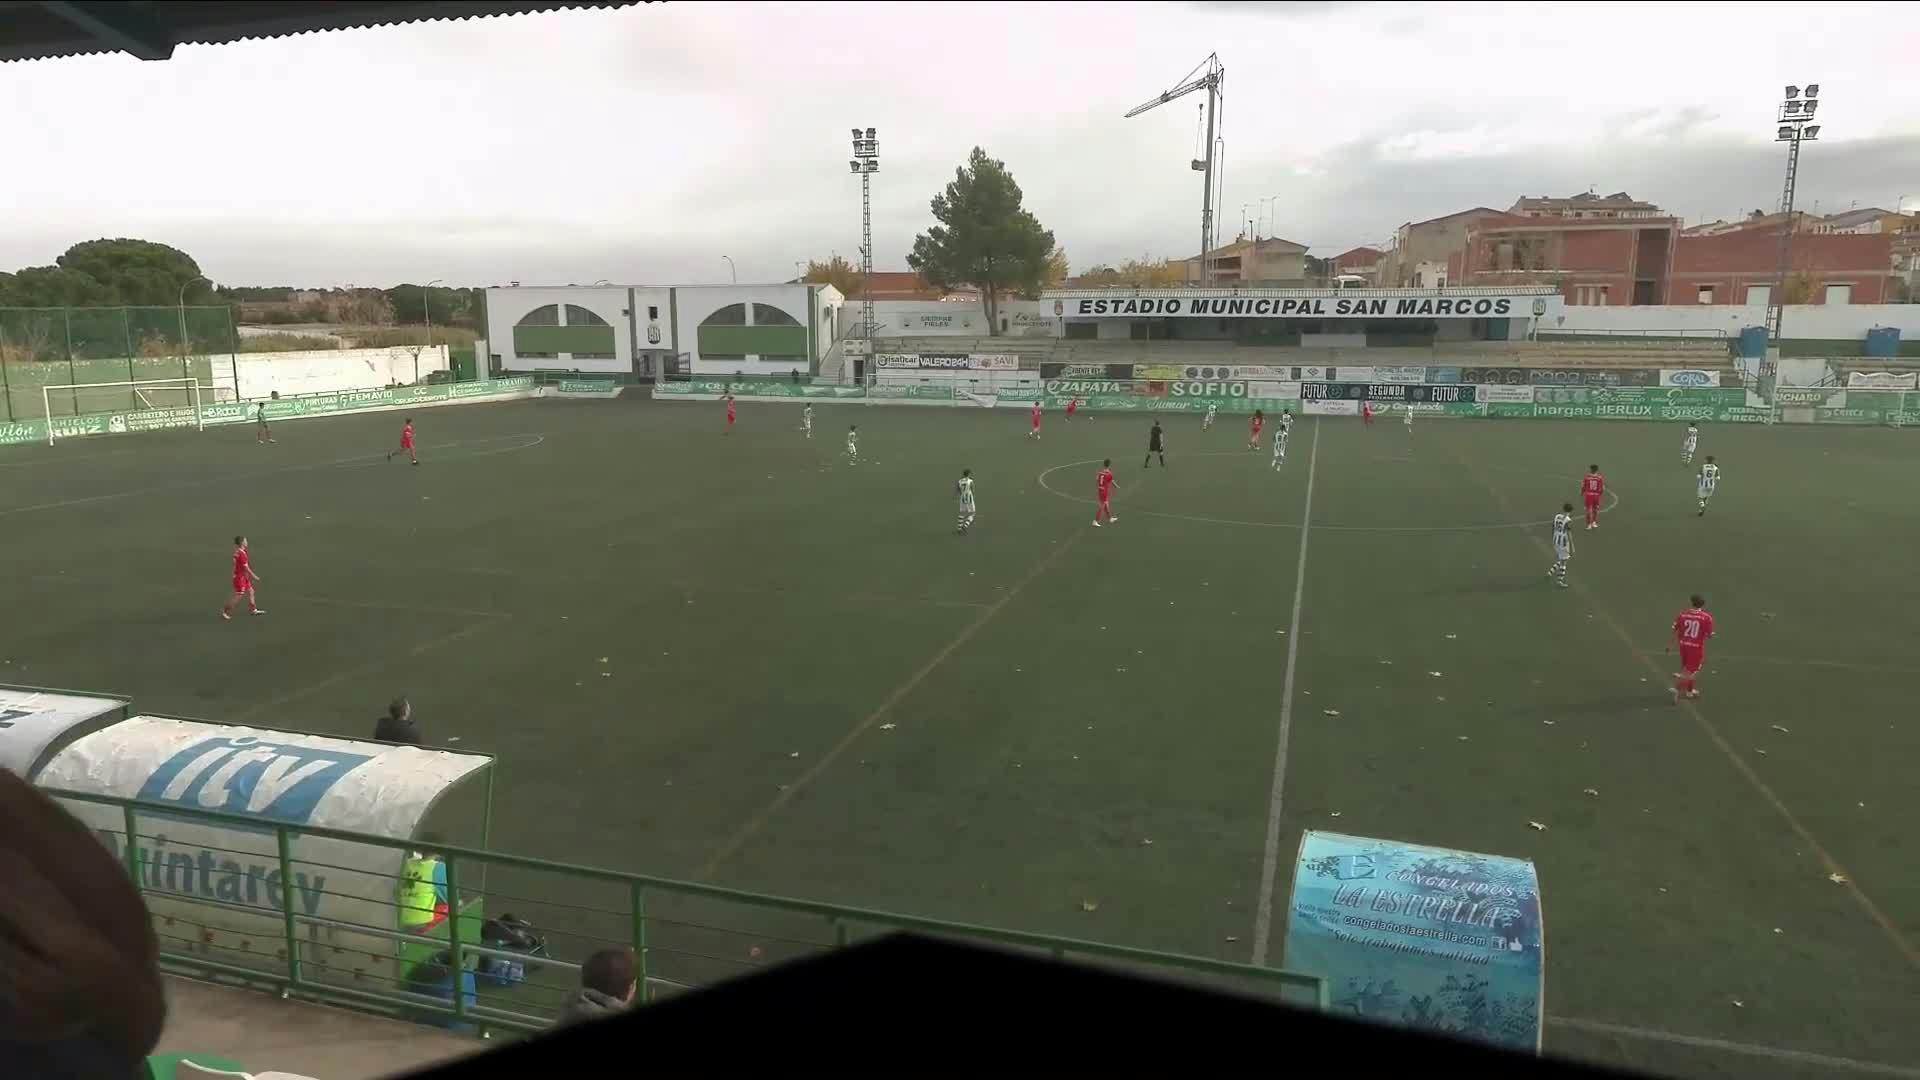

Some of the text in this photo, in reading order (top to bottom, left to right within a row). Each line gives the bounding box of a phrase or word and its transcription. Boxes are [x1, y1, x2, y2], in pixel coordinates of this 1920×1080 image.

[1079, 299, 1511, 314] ESTADIO MUNICIPAL SAN MARCOS
[1672, 373, 1706, 384] CORAL
[1060, 382, 1121, 392] ZAPATA
[1171, 382, 1246, 397] SOFIO
[1302, 384, 1328, 399] FUTUR
[1368, 385, 1405, 396] SEGUNDA
[1432, 386, 1459, 401] FUTUR
[1596, 405, 1652, 415] HERLUX
[1684, 619, 1700, 638] 20
[1333, 884, 1368, 908] LA
[1370, 888, 1500, 929] ESTRELLA
[1343, 915, 1487, 946] congeladoslaestrella.com
